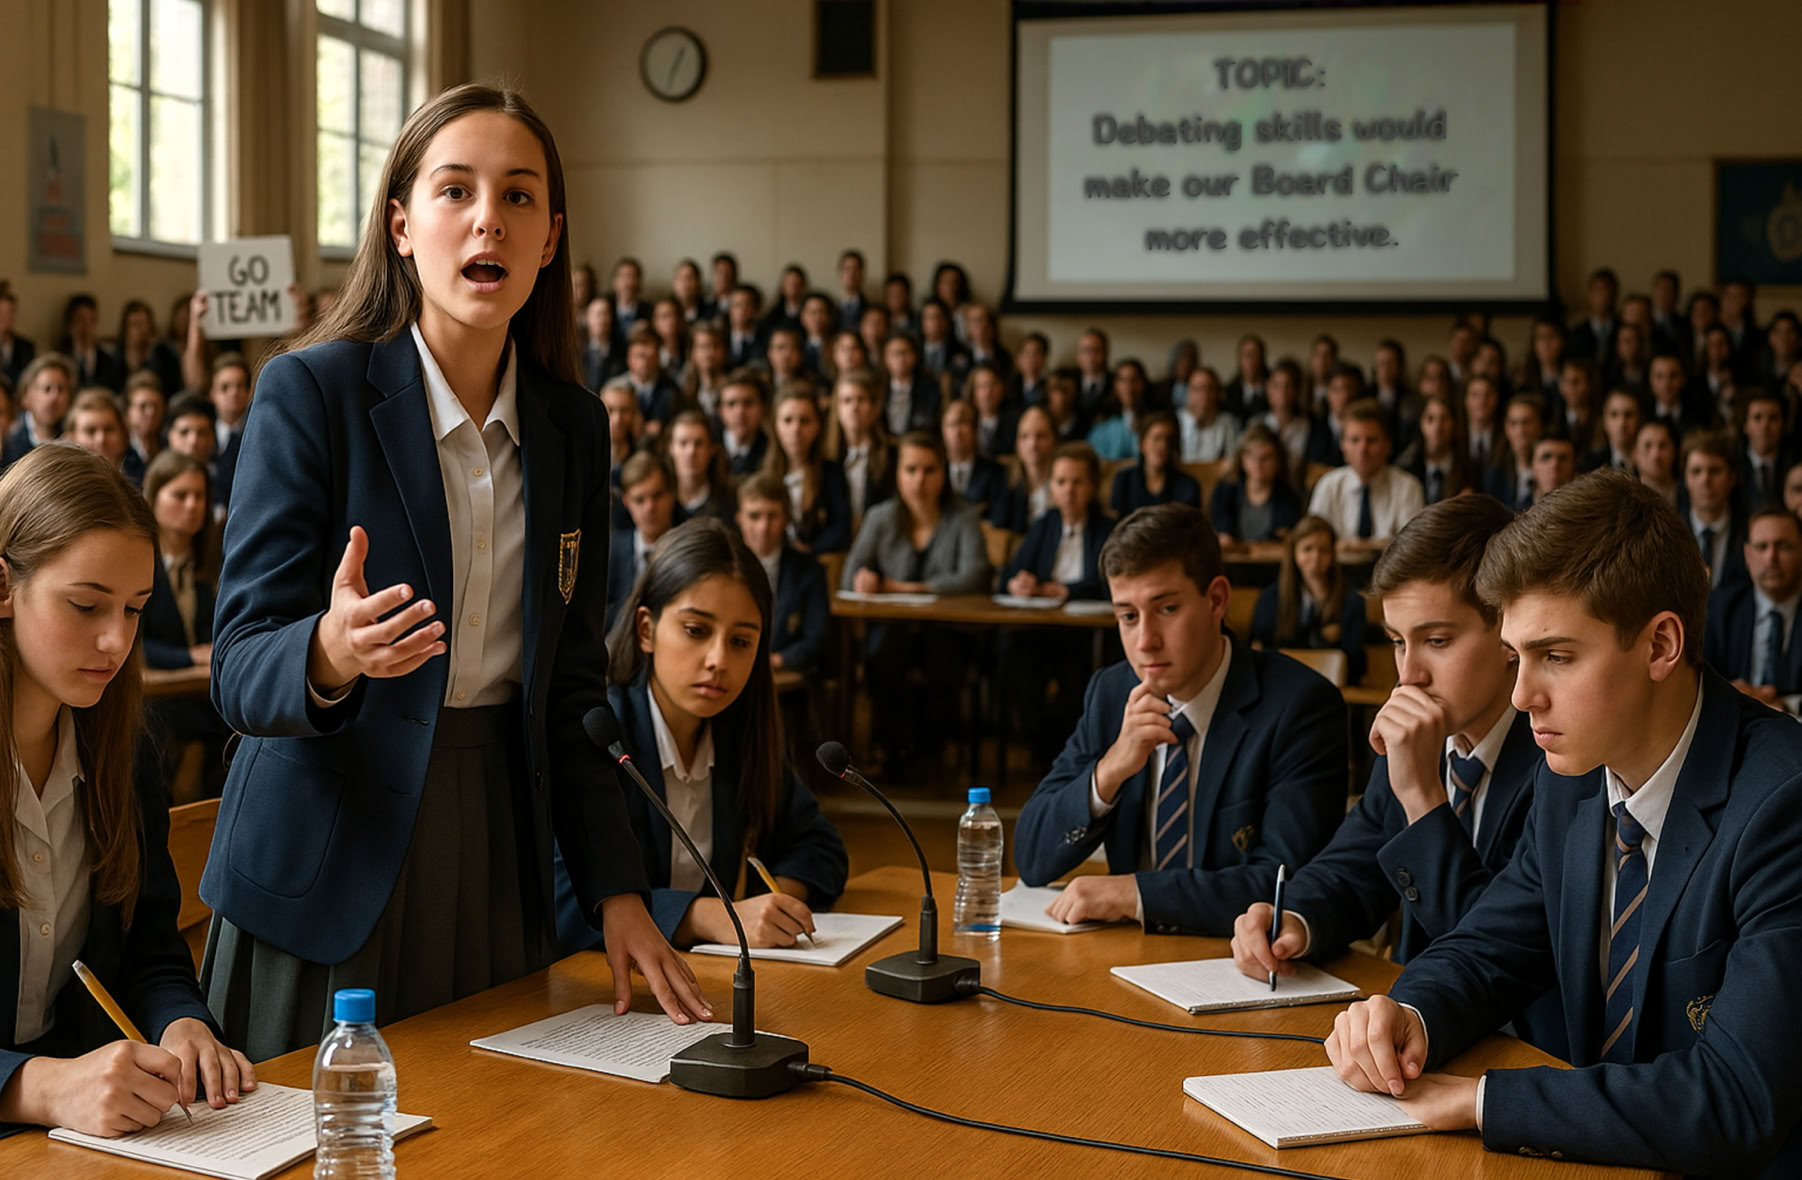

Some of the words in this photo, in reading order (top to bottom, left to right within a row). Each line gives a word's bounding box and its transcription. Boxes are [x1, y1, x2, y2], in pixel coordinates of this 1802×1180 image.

[1214, 57, 1326, 90] TOPIC:
[1092, 115, 1243, 151] Debating
[1254, 112, 1342, 143] skills
[1352, 109, 1448, 142] would
[1084, 167, 1171, 199] make
[1181, 174, 1239, 198] our
[1252, 164, 1353, 197] Board
[1364, 163, 1458, 195] Chair
[1145, 226, 1228, 252] more
[1239, 218, 1400, 250] effective.
[228, 255, 269, 287] GO
[209, 290, 281, 325] TEAM
